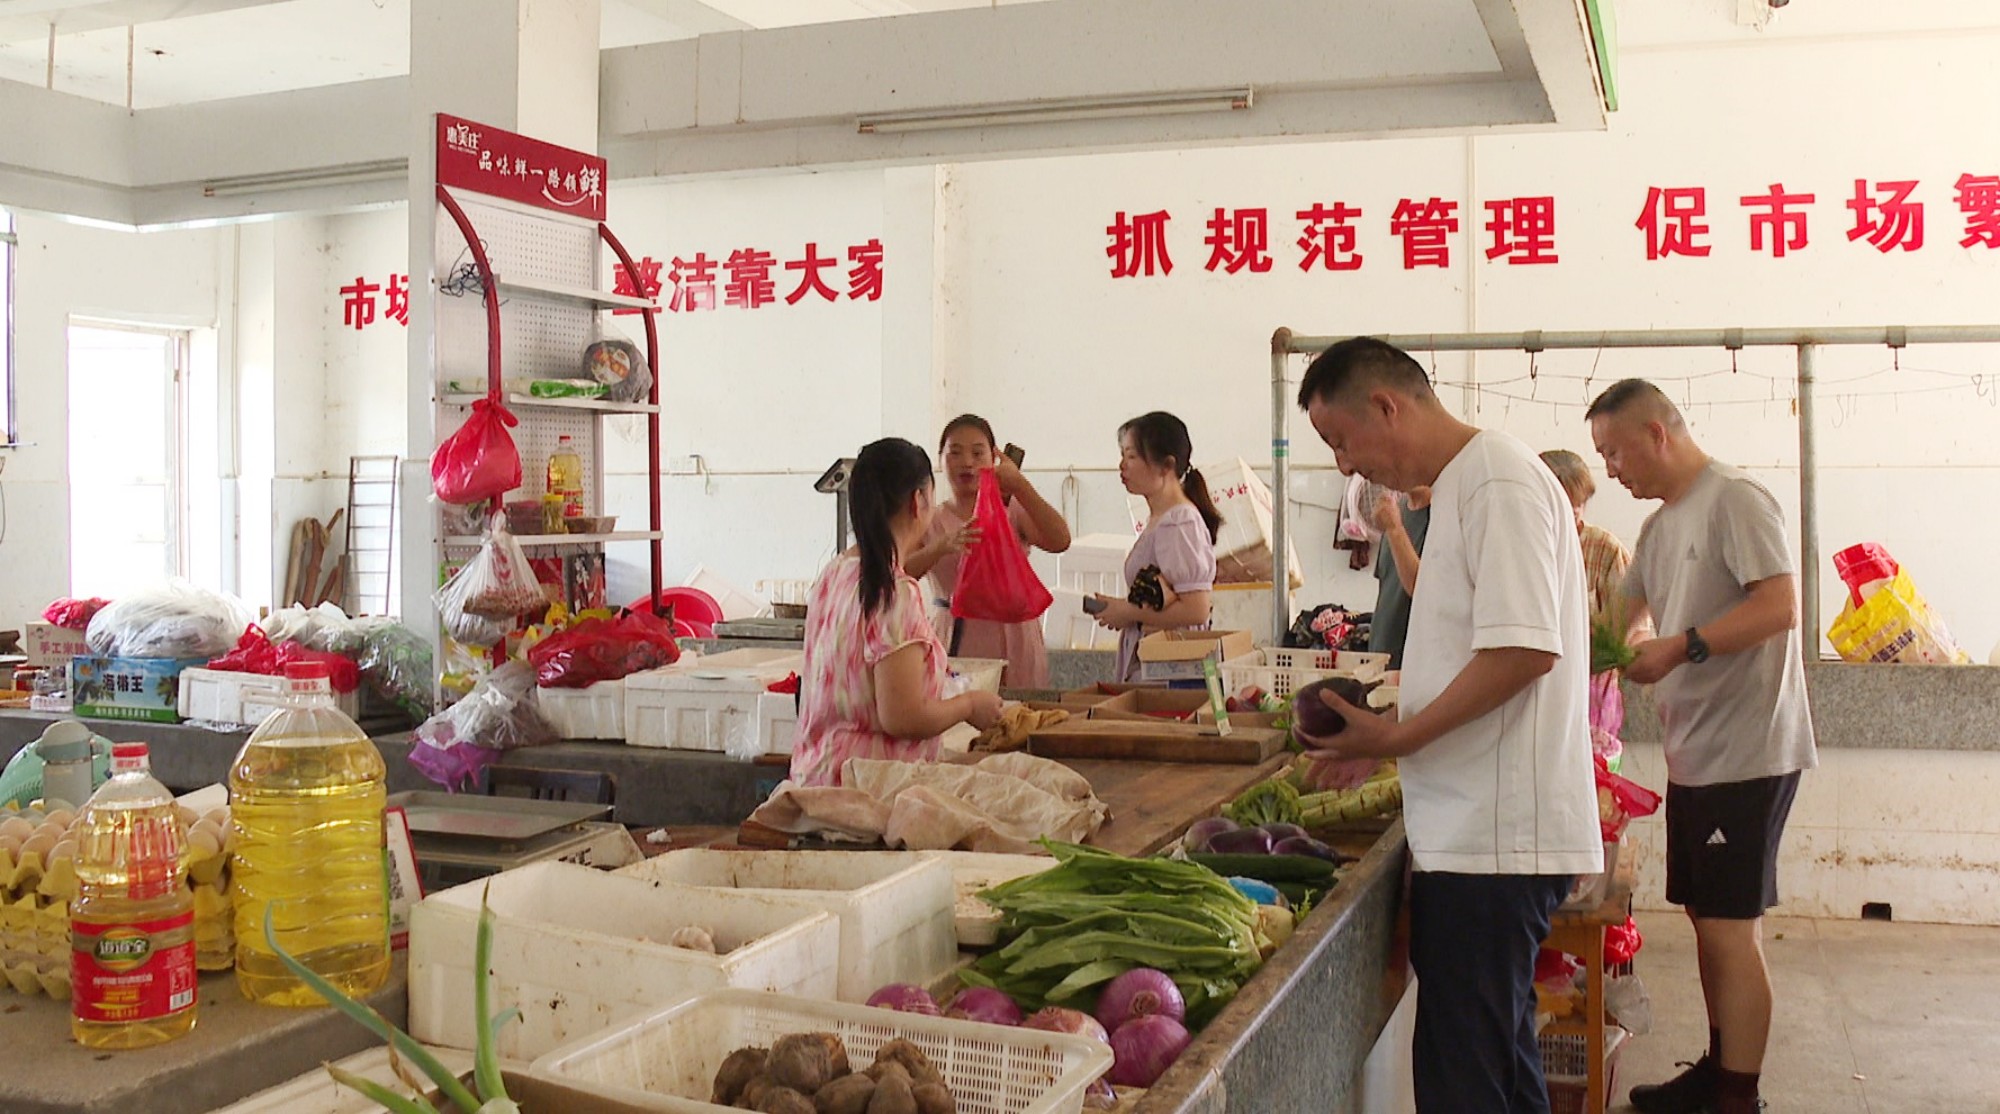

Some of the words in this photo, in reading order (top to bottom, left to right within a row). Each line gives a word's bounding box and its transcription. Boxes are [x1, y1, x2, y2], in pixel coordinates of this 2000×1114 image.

[1106, 196, 1559, 278] 抓规范管理
[1636, 173, 2000, 260] 促市场繁
[612, 238, 884, 316] 整洁靠大家
[102, 673, 144, 693] 海带王
